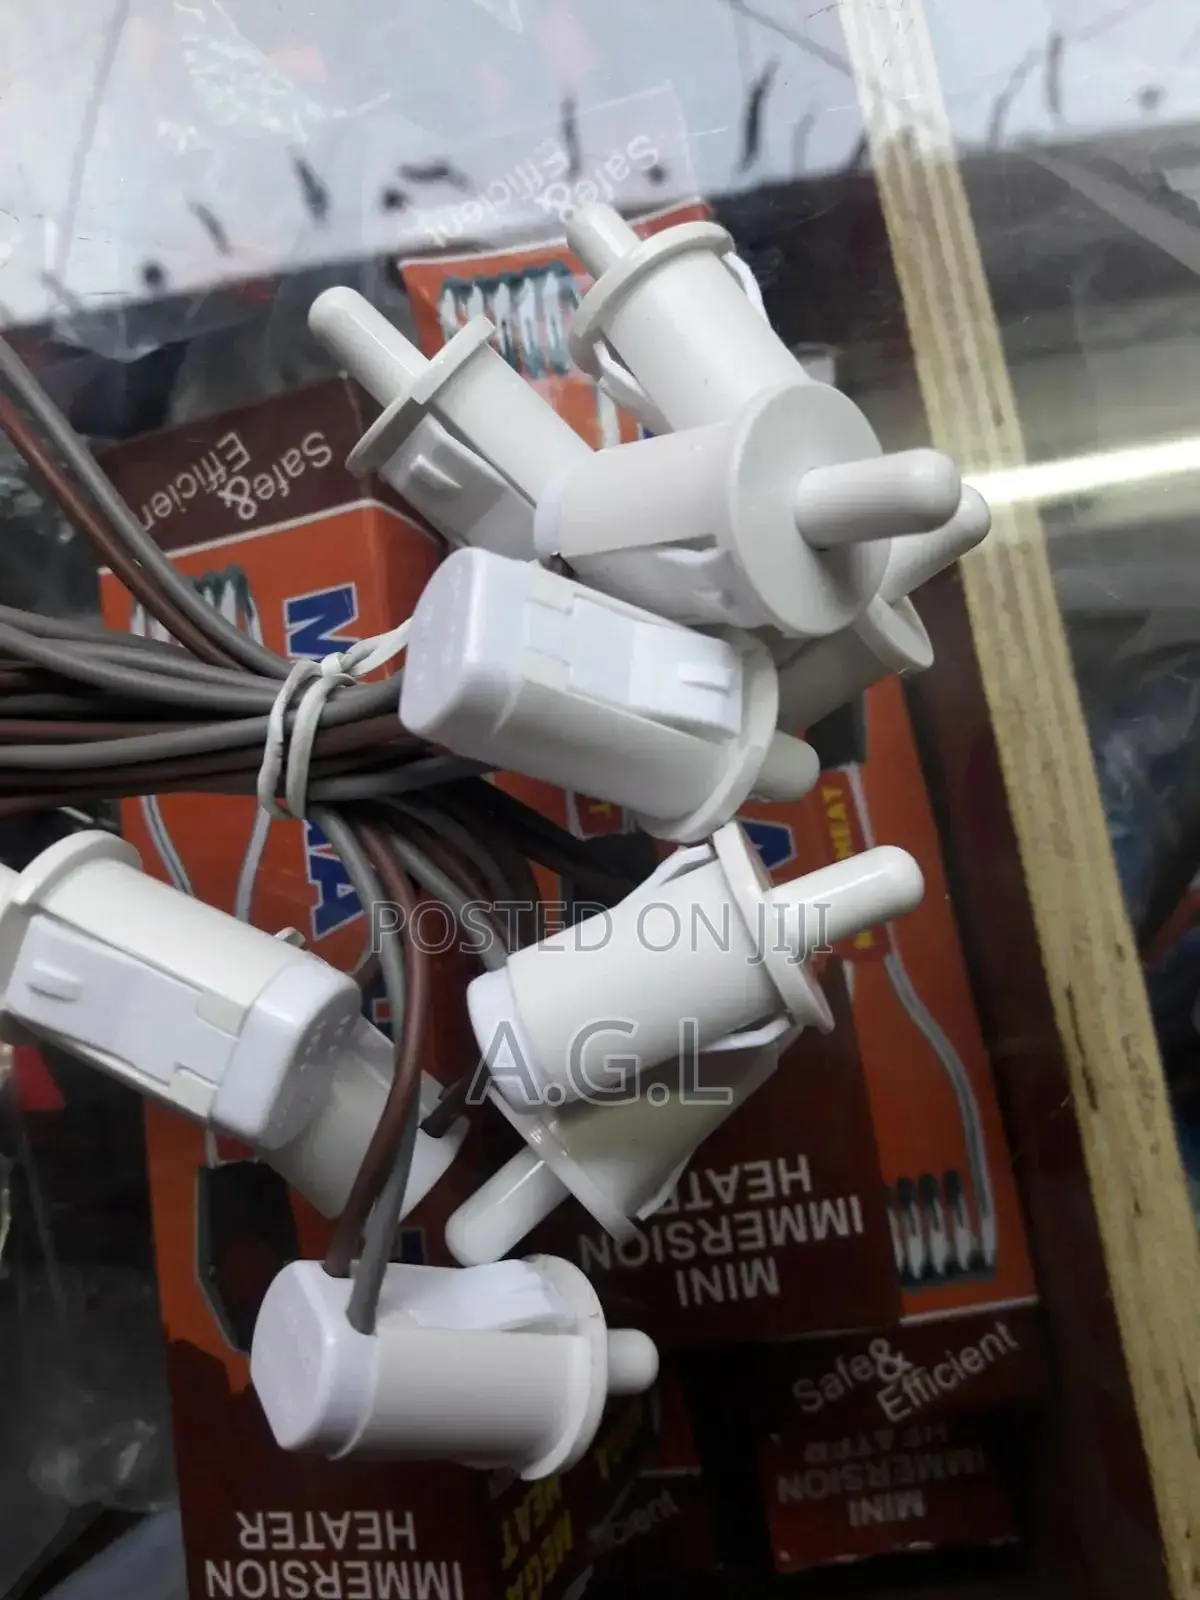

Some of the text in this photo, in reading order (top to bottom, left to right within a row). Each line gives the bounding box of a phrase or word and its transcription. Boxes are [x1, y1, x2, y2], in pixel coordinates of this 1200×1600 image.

[578, 1195, 864, 1271] IMMERSION
[674, 1256, 781, 1309] MINI
[876, 1320, 1020, 1422] Efficient
[235, 1510, 417, 1551] HEATER
[848, 1489, 928, 1527] MINI
[204, 1559, 465, 1600] IMMERSION
